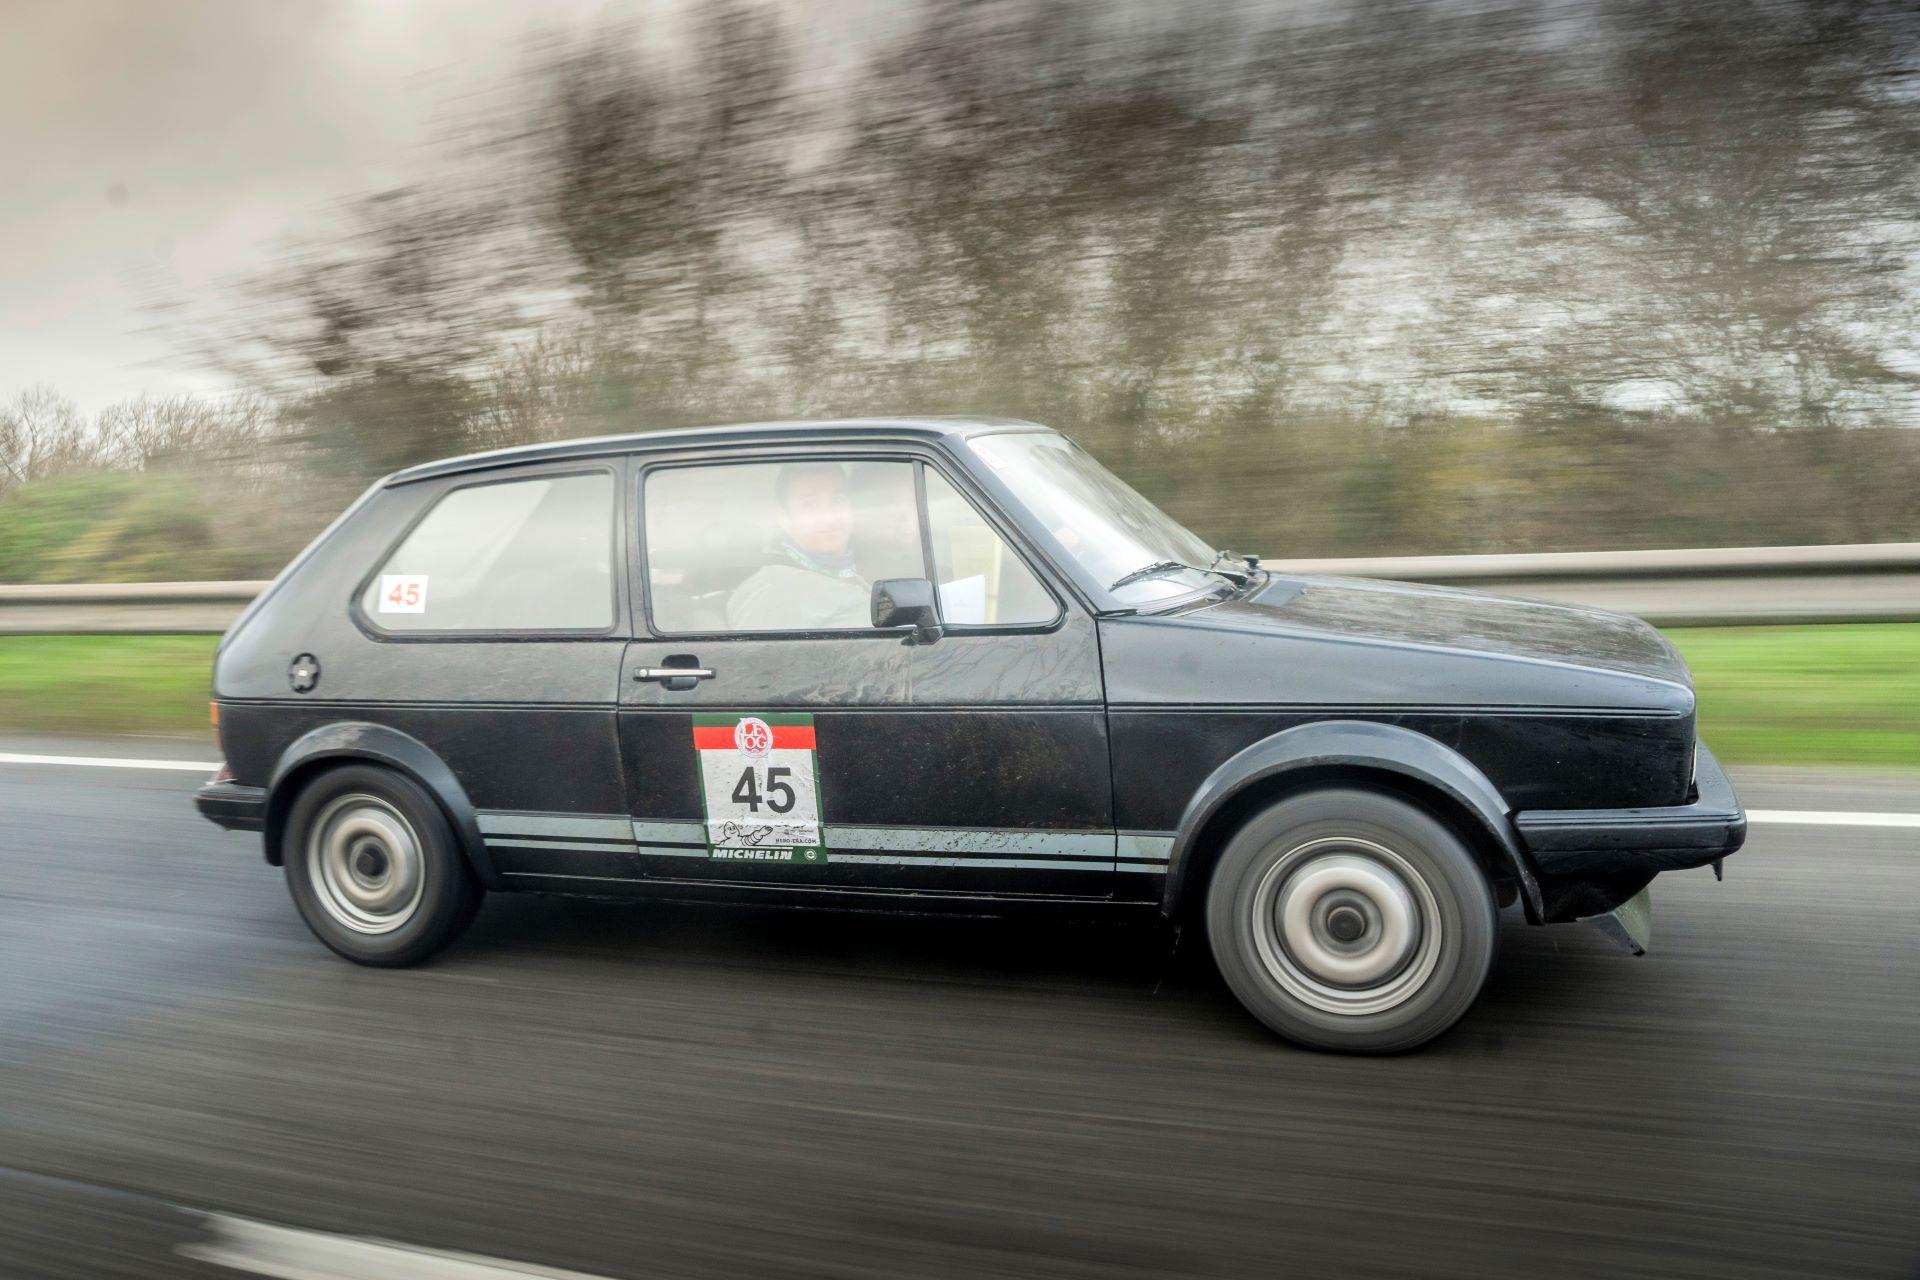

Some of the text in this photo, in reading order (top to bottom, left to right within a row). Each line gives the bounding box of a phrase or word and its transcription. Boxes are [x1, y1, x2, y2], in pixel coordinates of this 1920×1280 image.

[388, 583, 420, 606] 45
[742, 722, 766, 736] LE
[731, 766, 796, 814] 45
[712, 849, 793, 860] MICHELIN
